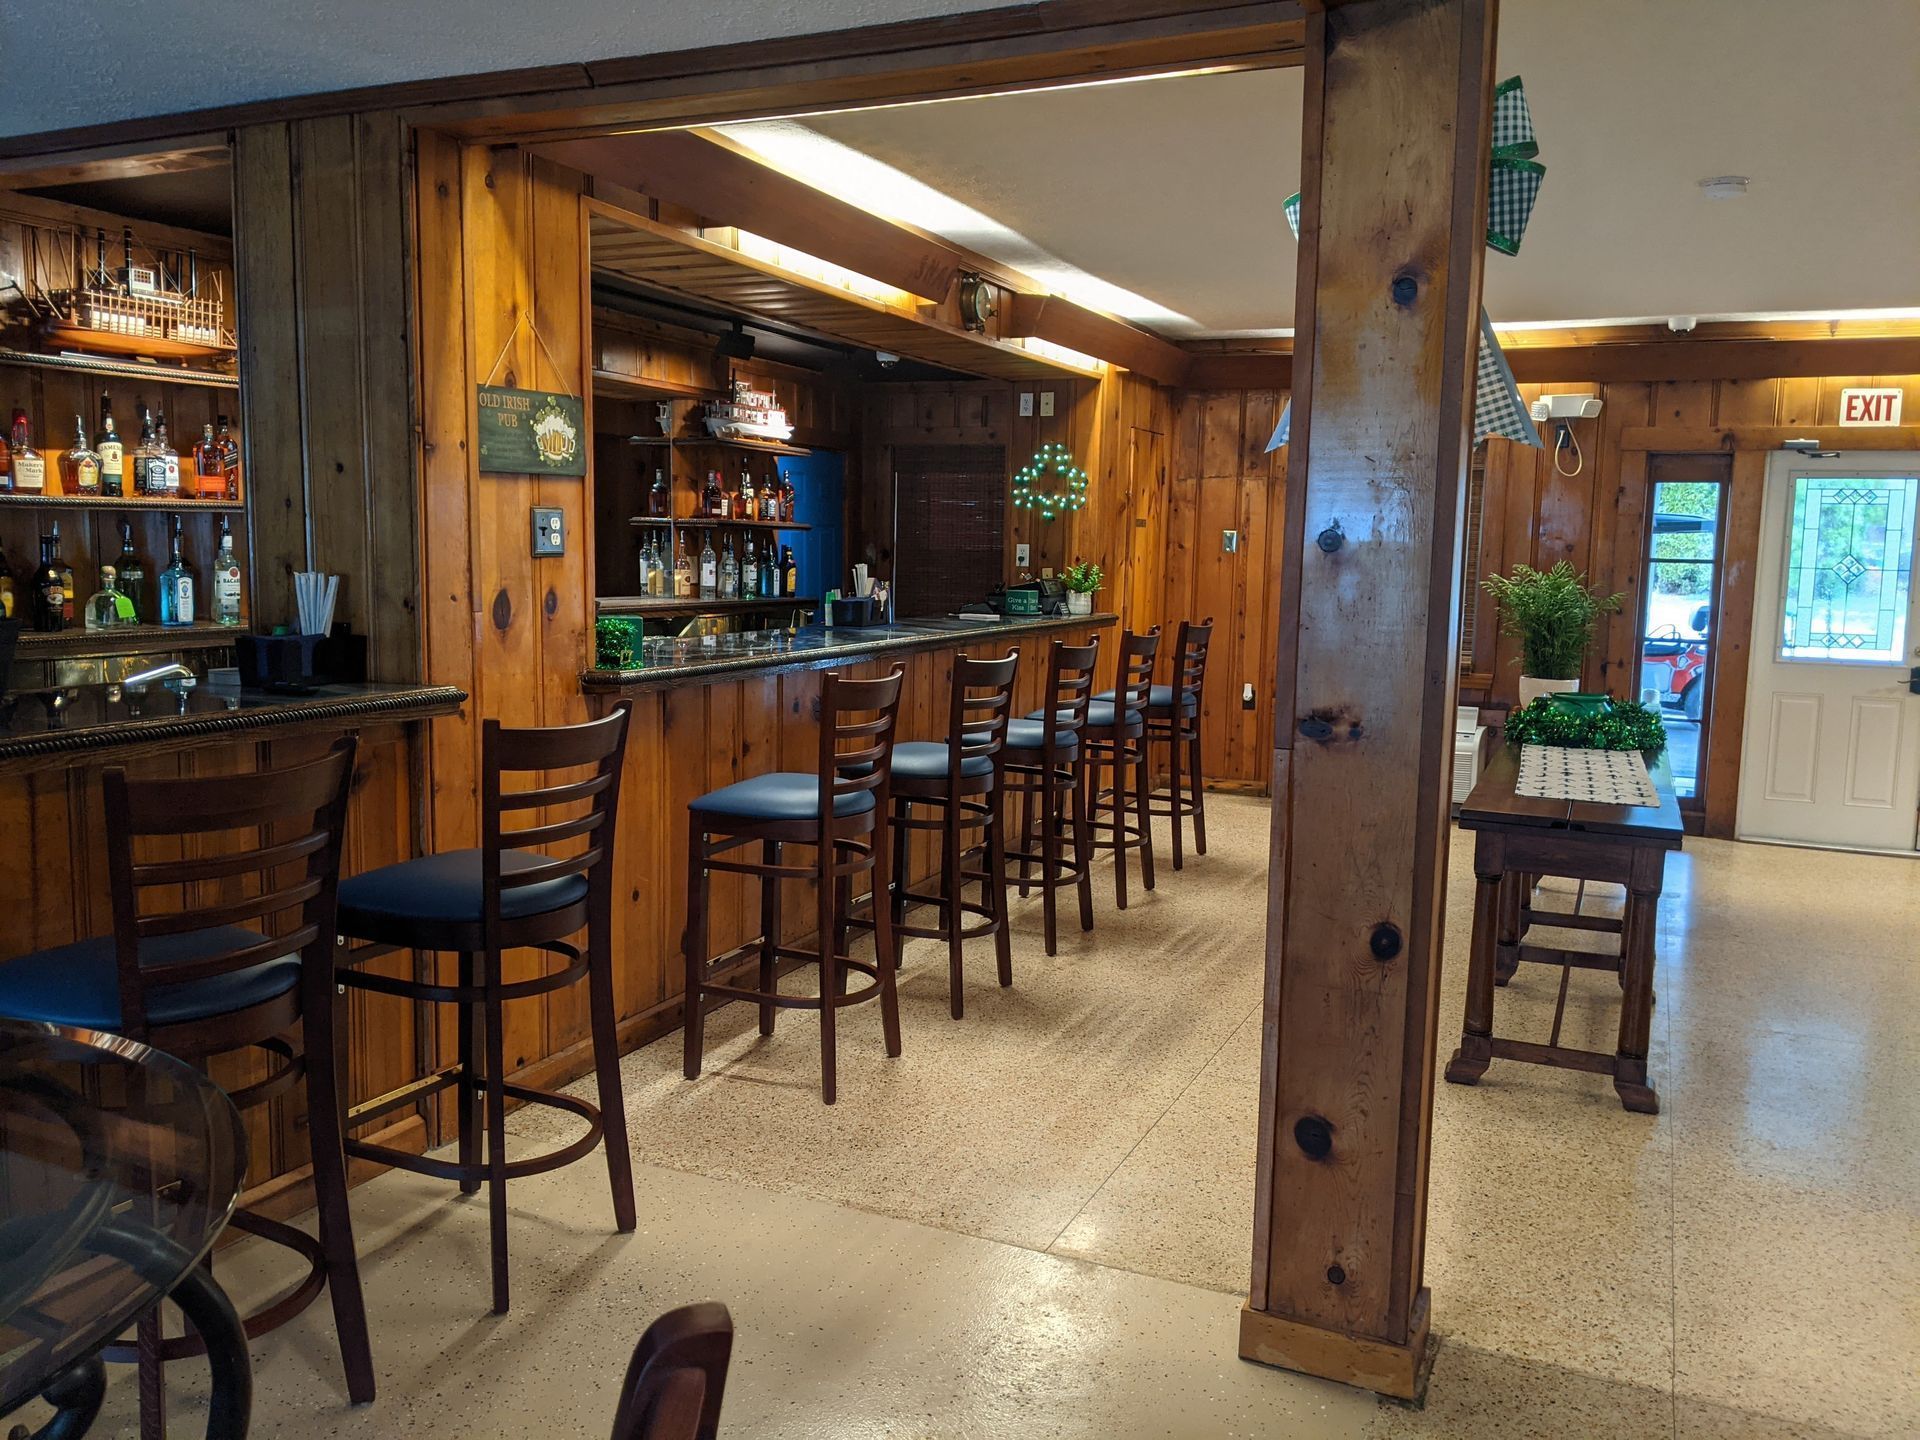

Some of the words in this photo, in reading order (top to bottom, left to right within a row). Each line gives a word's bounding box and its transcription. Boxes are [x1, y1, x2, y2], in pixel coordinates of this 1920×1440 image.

[479, 392, 500, 407] OLD
[503, 395, 530, 411] IRISH
[1845, 395, 1897, 421] EXIT
[498, 413, 518, 427] PUB
